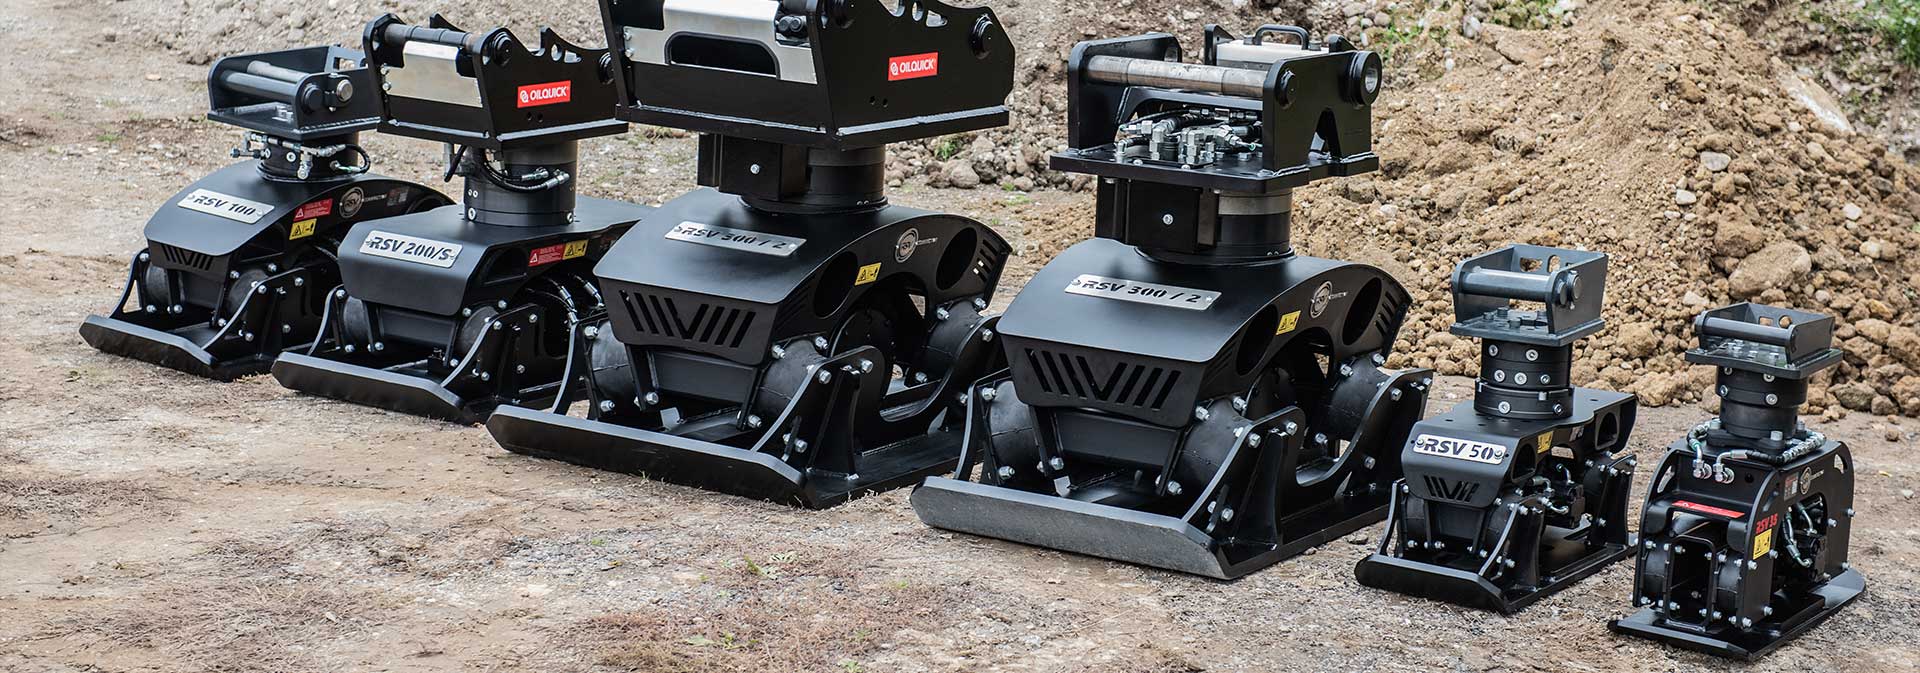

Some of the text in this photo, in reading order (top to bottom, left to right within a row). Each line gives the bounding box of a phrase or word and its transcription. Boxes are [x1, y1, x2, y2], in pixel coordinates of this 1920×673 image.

[900, 59, 934, 73] OILQUICK
[530, 86, 567, 101] OILQUICK
[193, 195, 256, 216] RSV 100
[682, 226, 720, 239] RSV
[721, 234, 756, 245] 300
[369, 236, 452, 260] RSV 200/S
[1082, 280, 1125, 292] RSV
[1128, 286, 1168, 298] 300
[1185, 294, 1202, 303] 2
[1424, 438, 1494, 460] RSV 50
